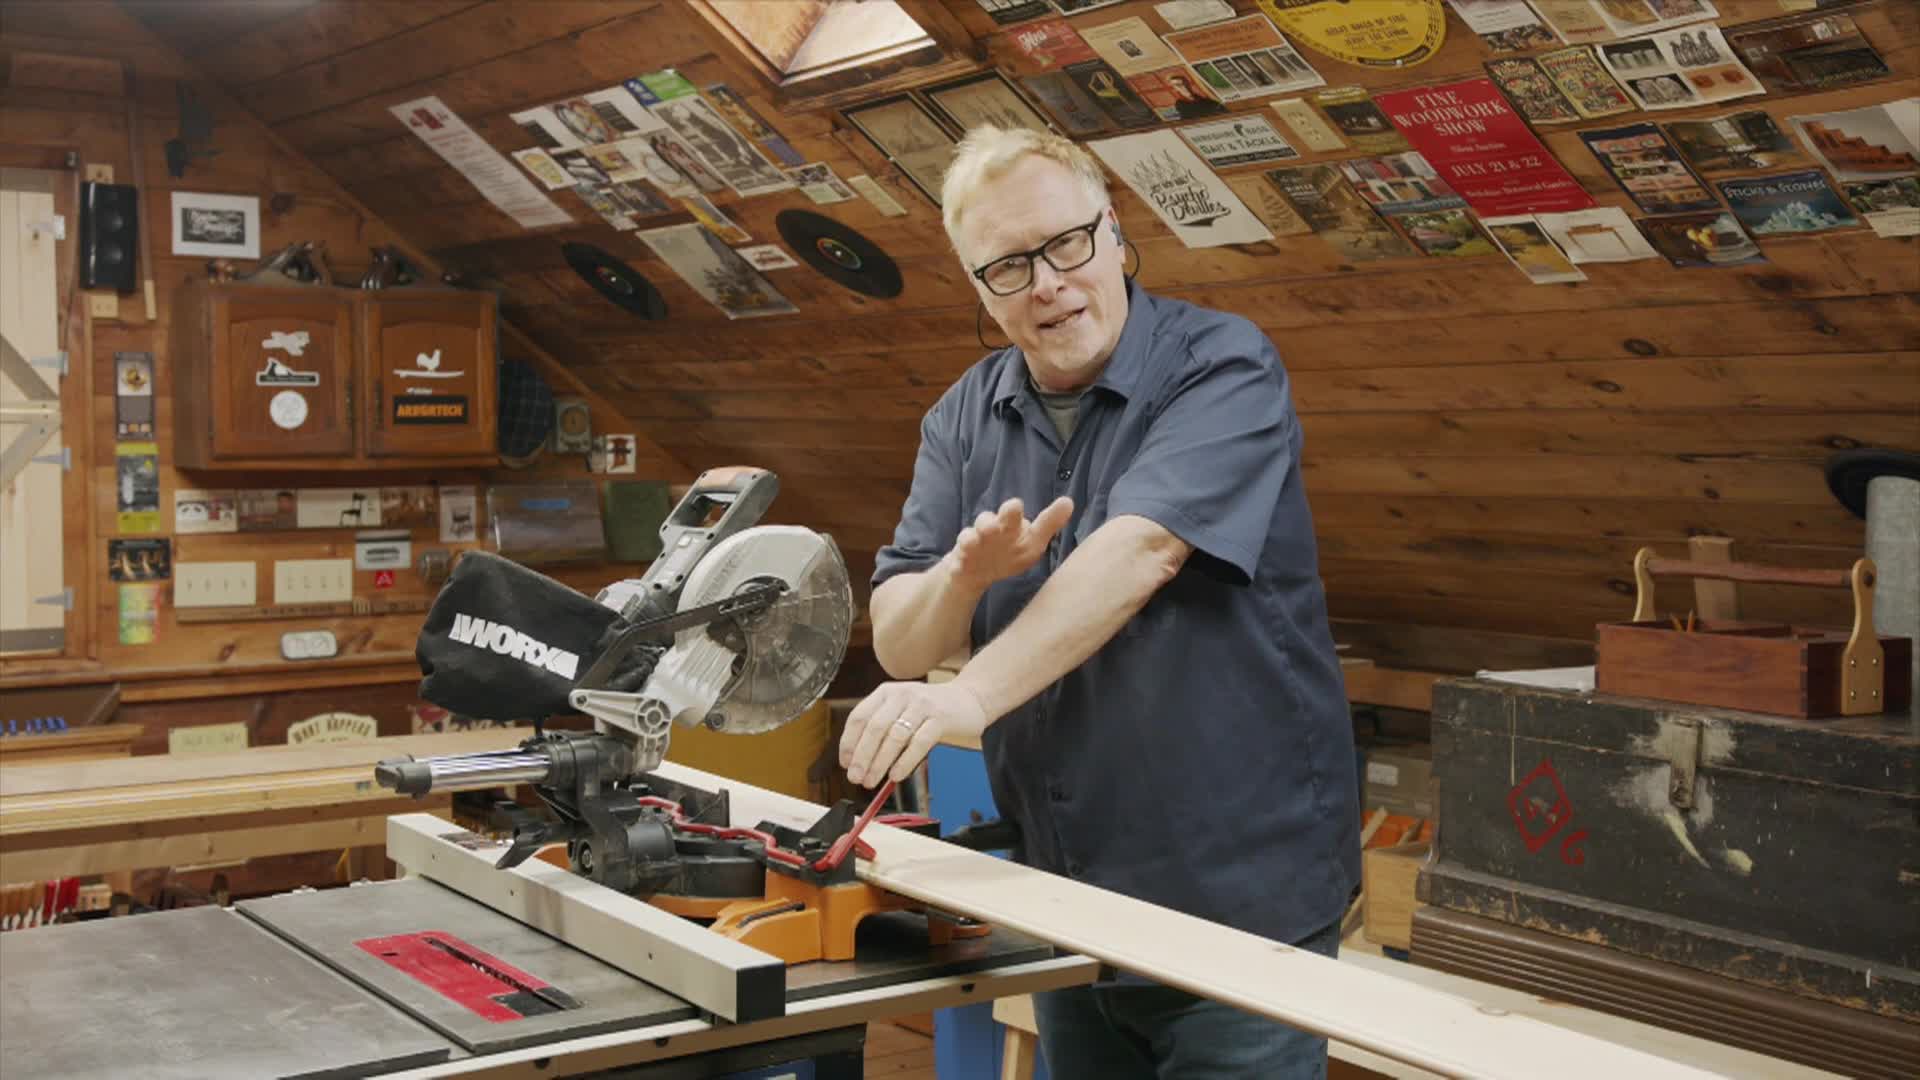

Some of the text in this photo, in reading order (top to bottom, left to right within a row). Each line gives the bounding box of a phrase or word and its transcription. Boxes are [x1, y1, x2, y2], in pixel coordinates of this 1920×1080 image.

[1413, 90, 1463, 109] FINE
[1393, 99, 1508, 128] WOODWORK
[1433, 119, 1488, 138] SHOW
[1450, 156, 1542, 177] JULY 21 & 22
[1151, 186, 1210, 208] Psycho
[396, 404, 464, 417] ARBORTECH
[449, 612, 579, 681] WORX
